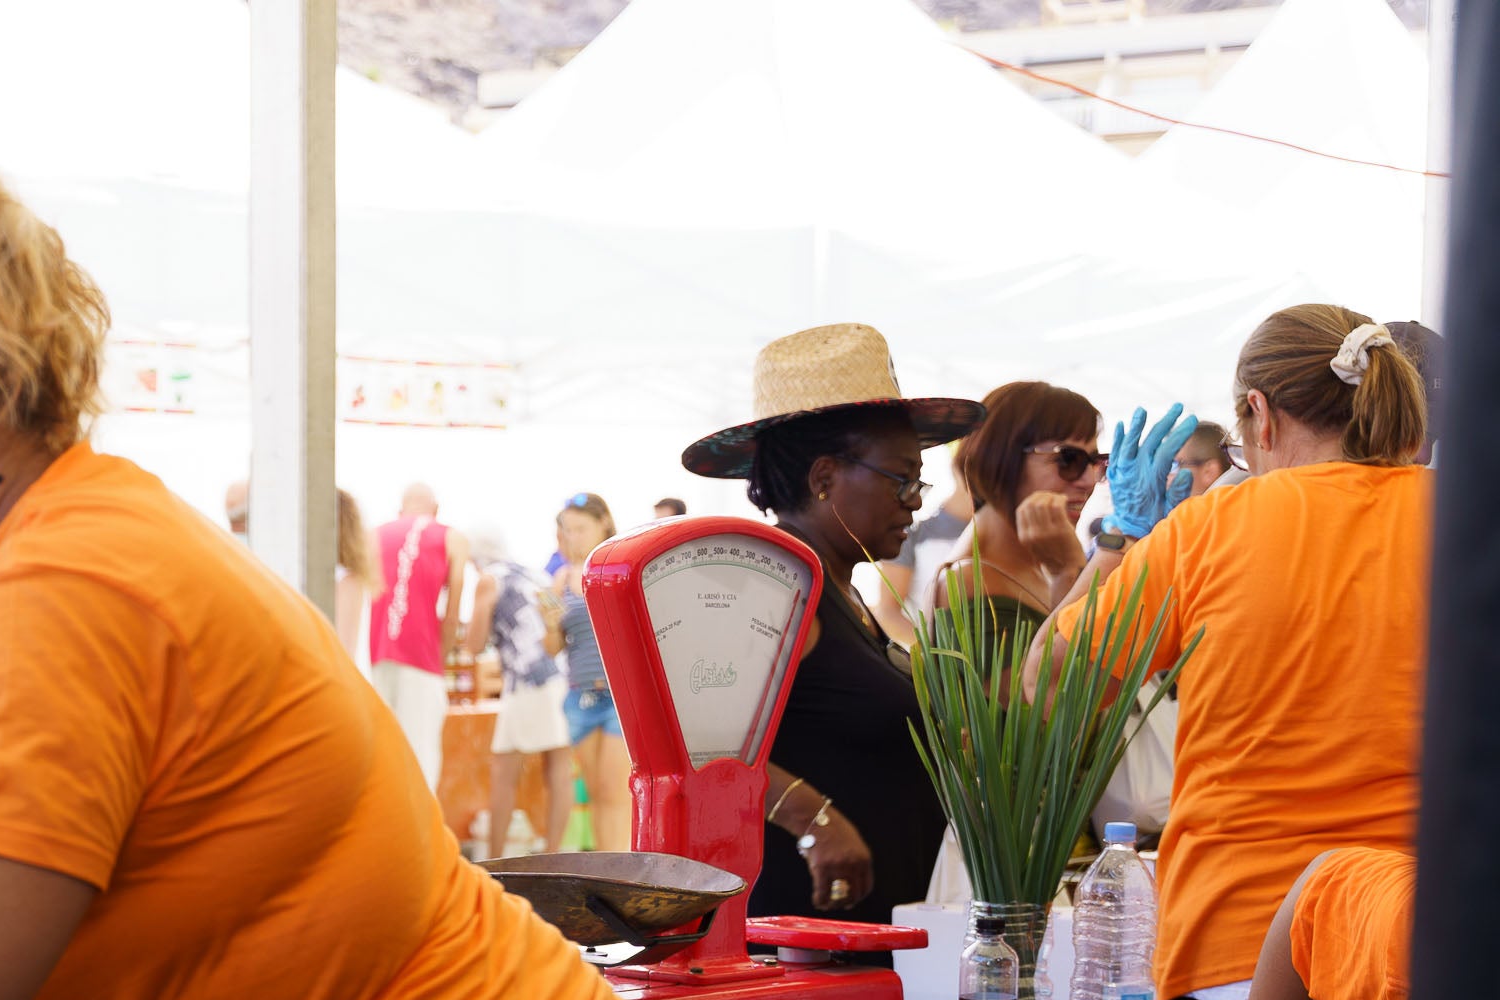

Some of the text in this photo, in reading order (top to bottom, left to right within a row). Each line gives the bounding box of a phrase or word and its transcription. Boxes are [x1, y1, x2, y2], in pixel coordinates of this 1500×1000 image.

[697, 547, 708, 557] 600
[713, 547, 724, 555] 500
[729, 548, 740, 557] 400
[745, 550, 756, 560] 300
[760, 555, 771, 566] 200
[776, 562, 786, 573] 100
